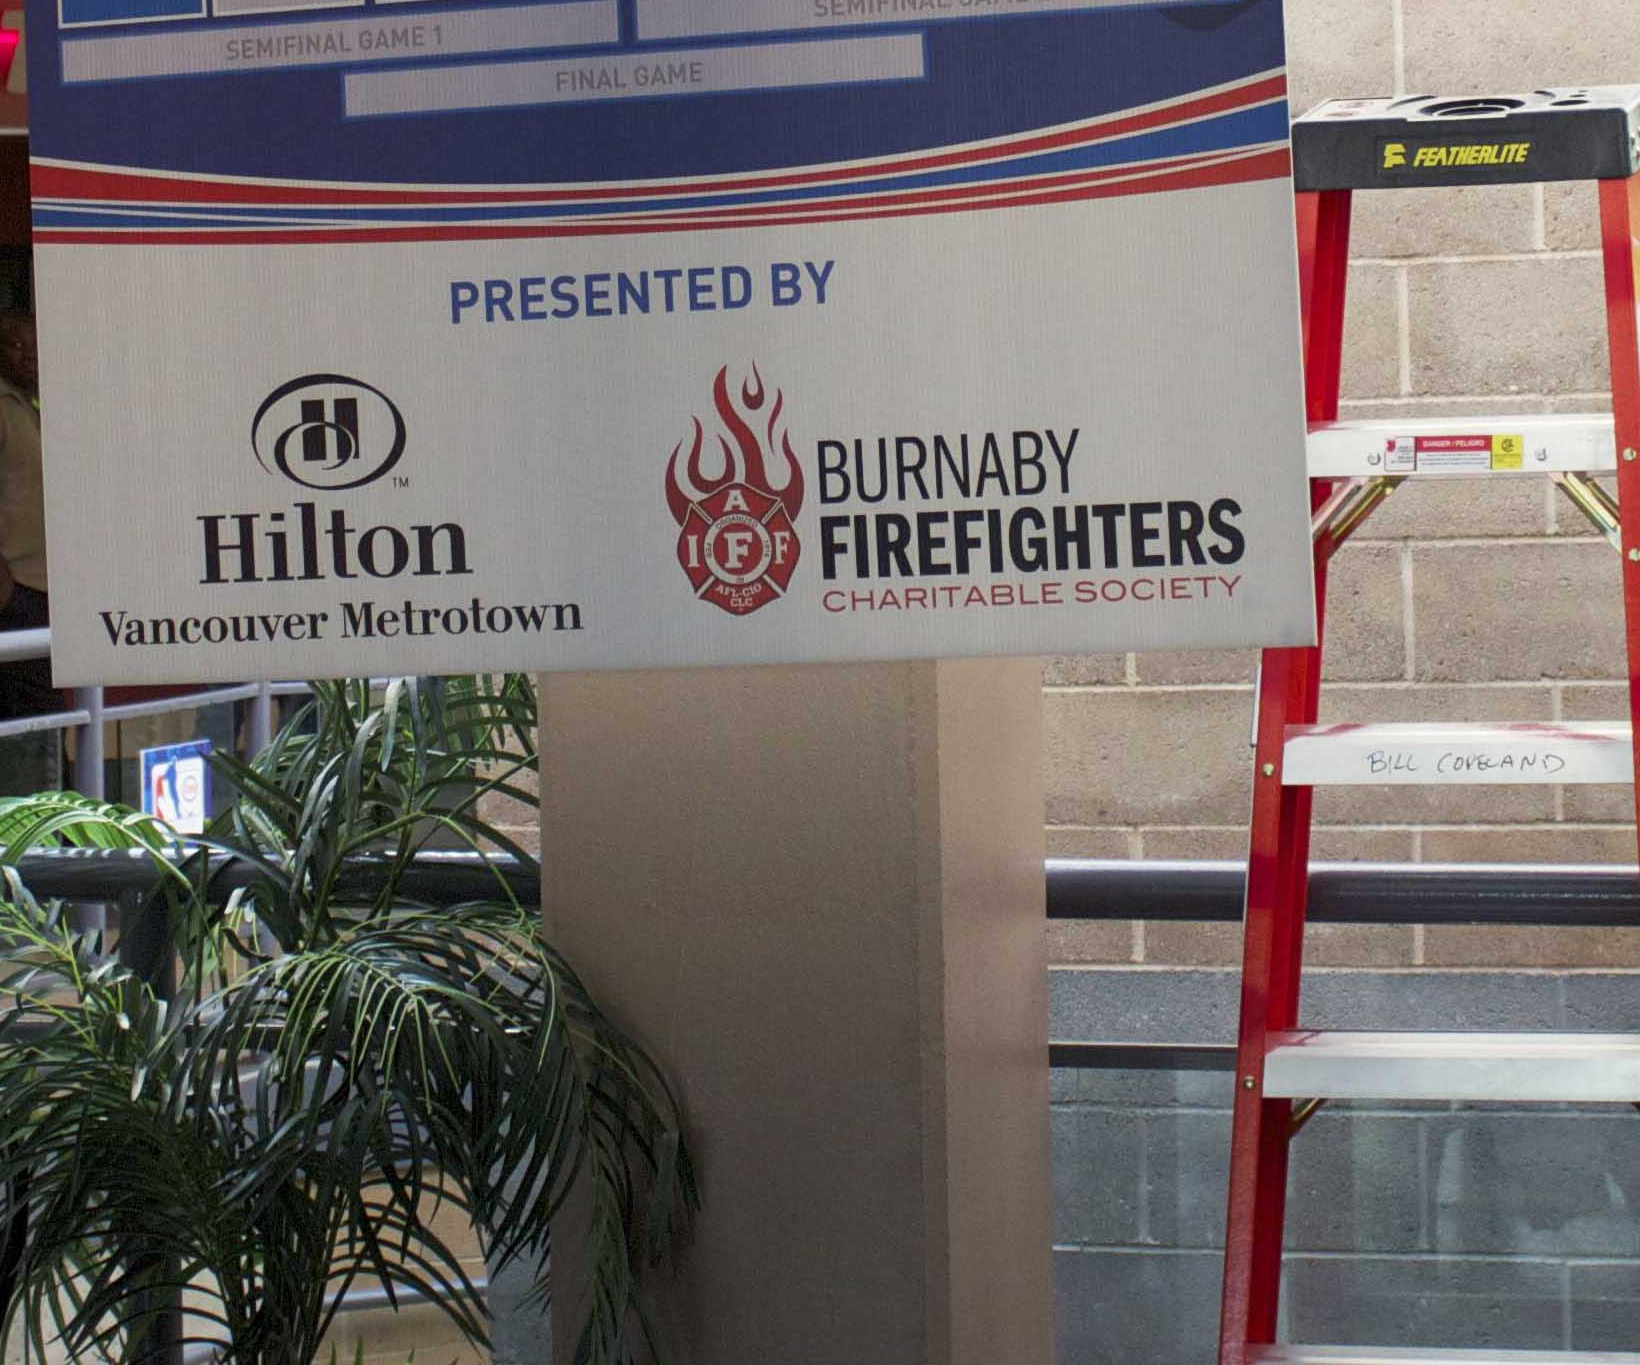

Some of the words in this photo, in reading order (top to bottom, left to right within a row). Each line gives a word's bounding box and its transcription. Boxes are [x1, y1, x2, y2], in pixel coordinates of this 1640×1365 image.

[226, 32, 352, 61] SEMIFINAL
[359, 26, 424, 50] GAME
[434, 25, 442, 45] 1
[1413, 143, 1529, 166] FEATHERLITE
[451, 266, 751, 324] PRESENTED
[771, 261, 834, 306] BY
[1367, 751, 1416, 773] BILL
